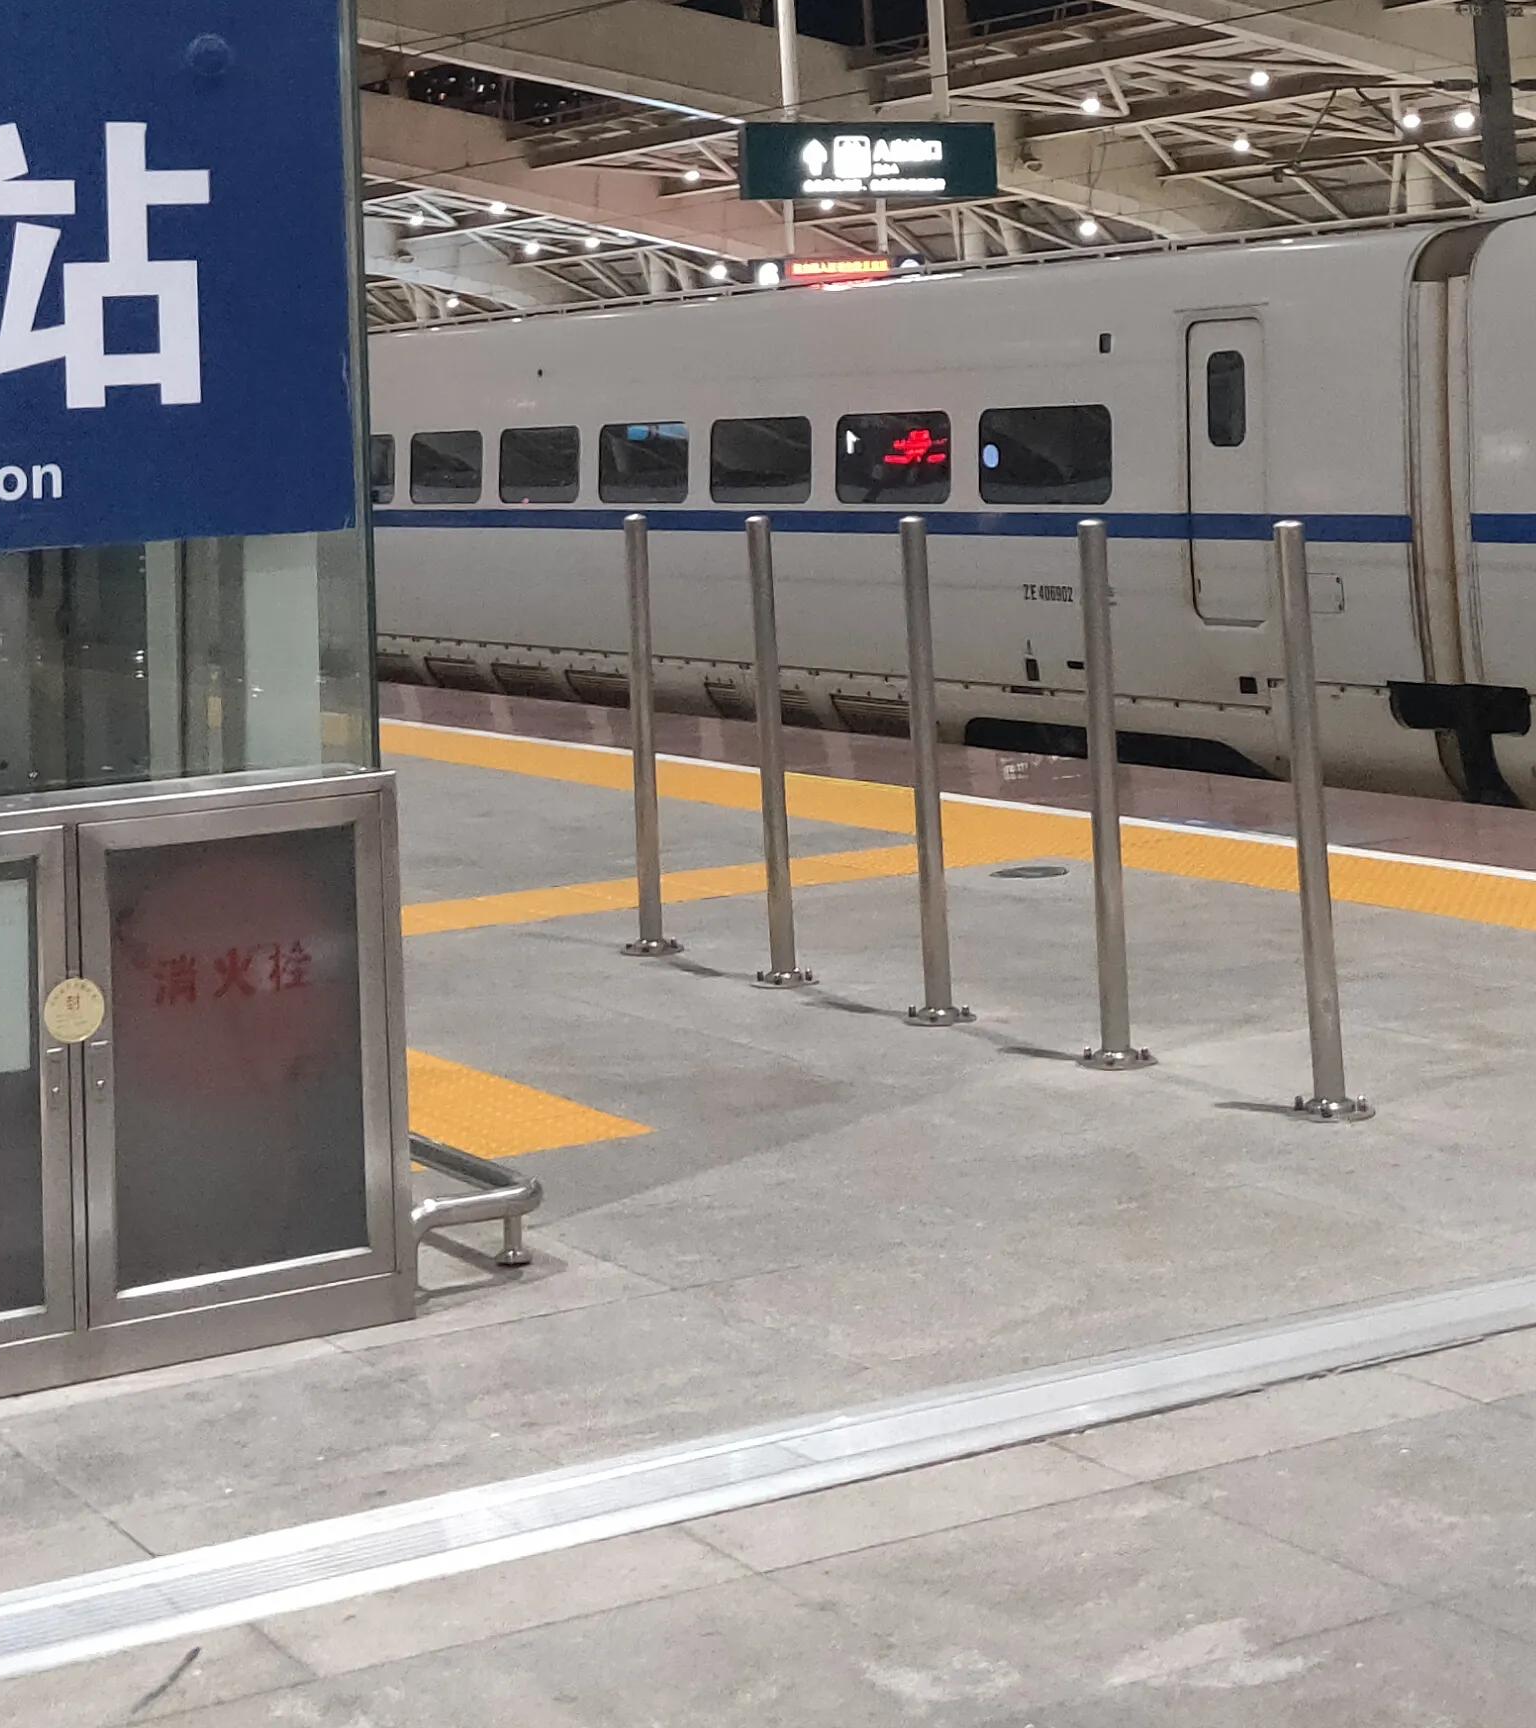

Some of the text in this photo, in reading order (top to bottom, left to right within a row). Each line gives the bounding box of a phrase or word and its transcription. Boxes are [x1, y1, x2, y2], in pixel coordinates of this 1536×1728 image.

[1022, 583, 1038, 601] ZE
[154, 939, 313, 1006] 消火栓
